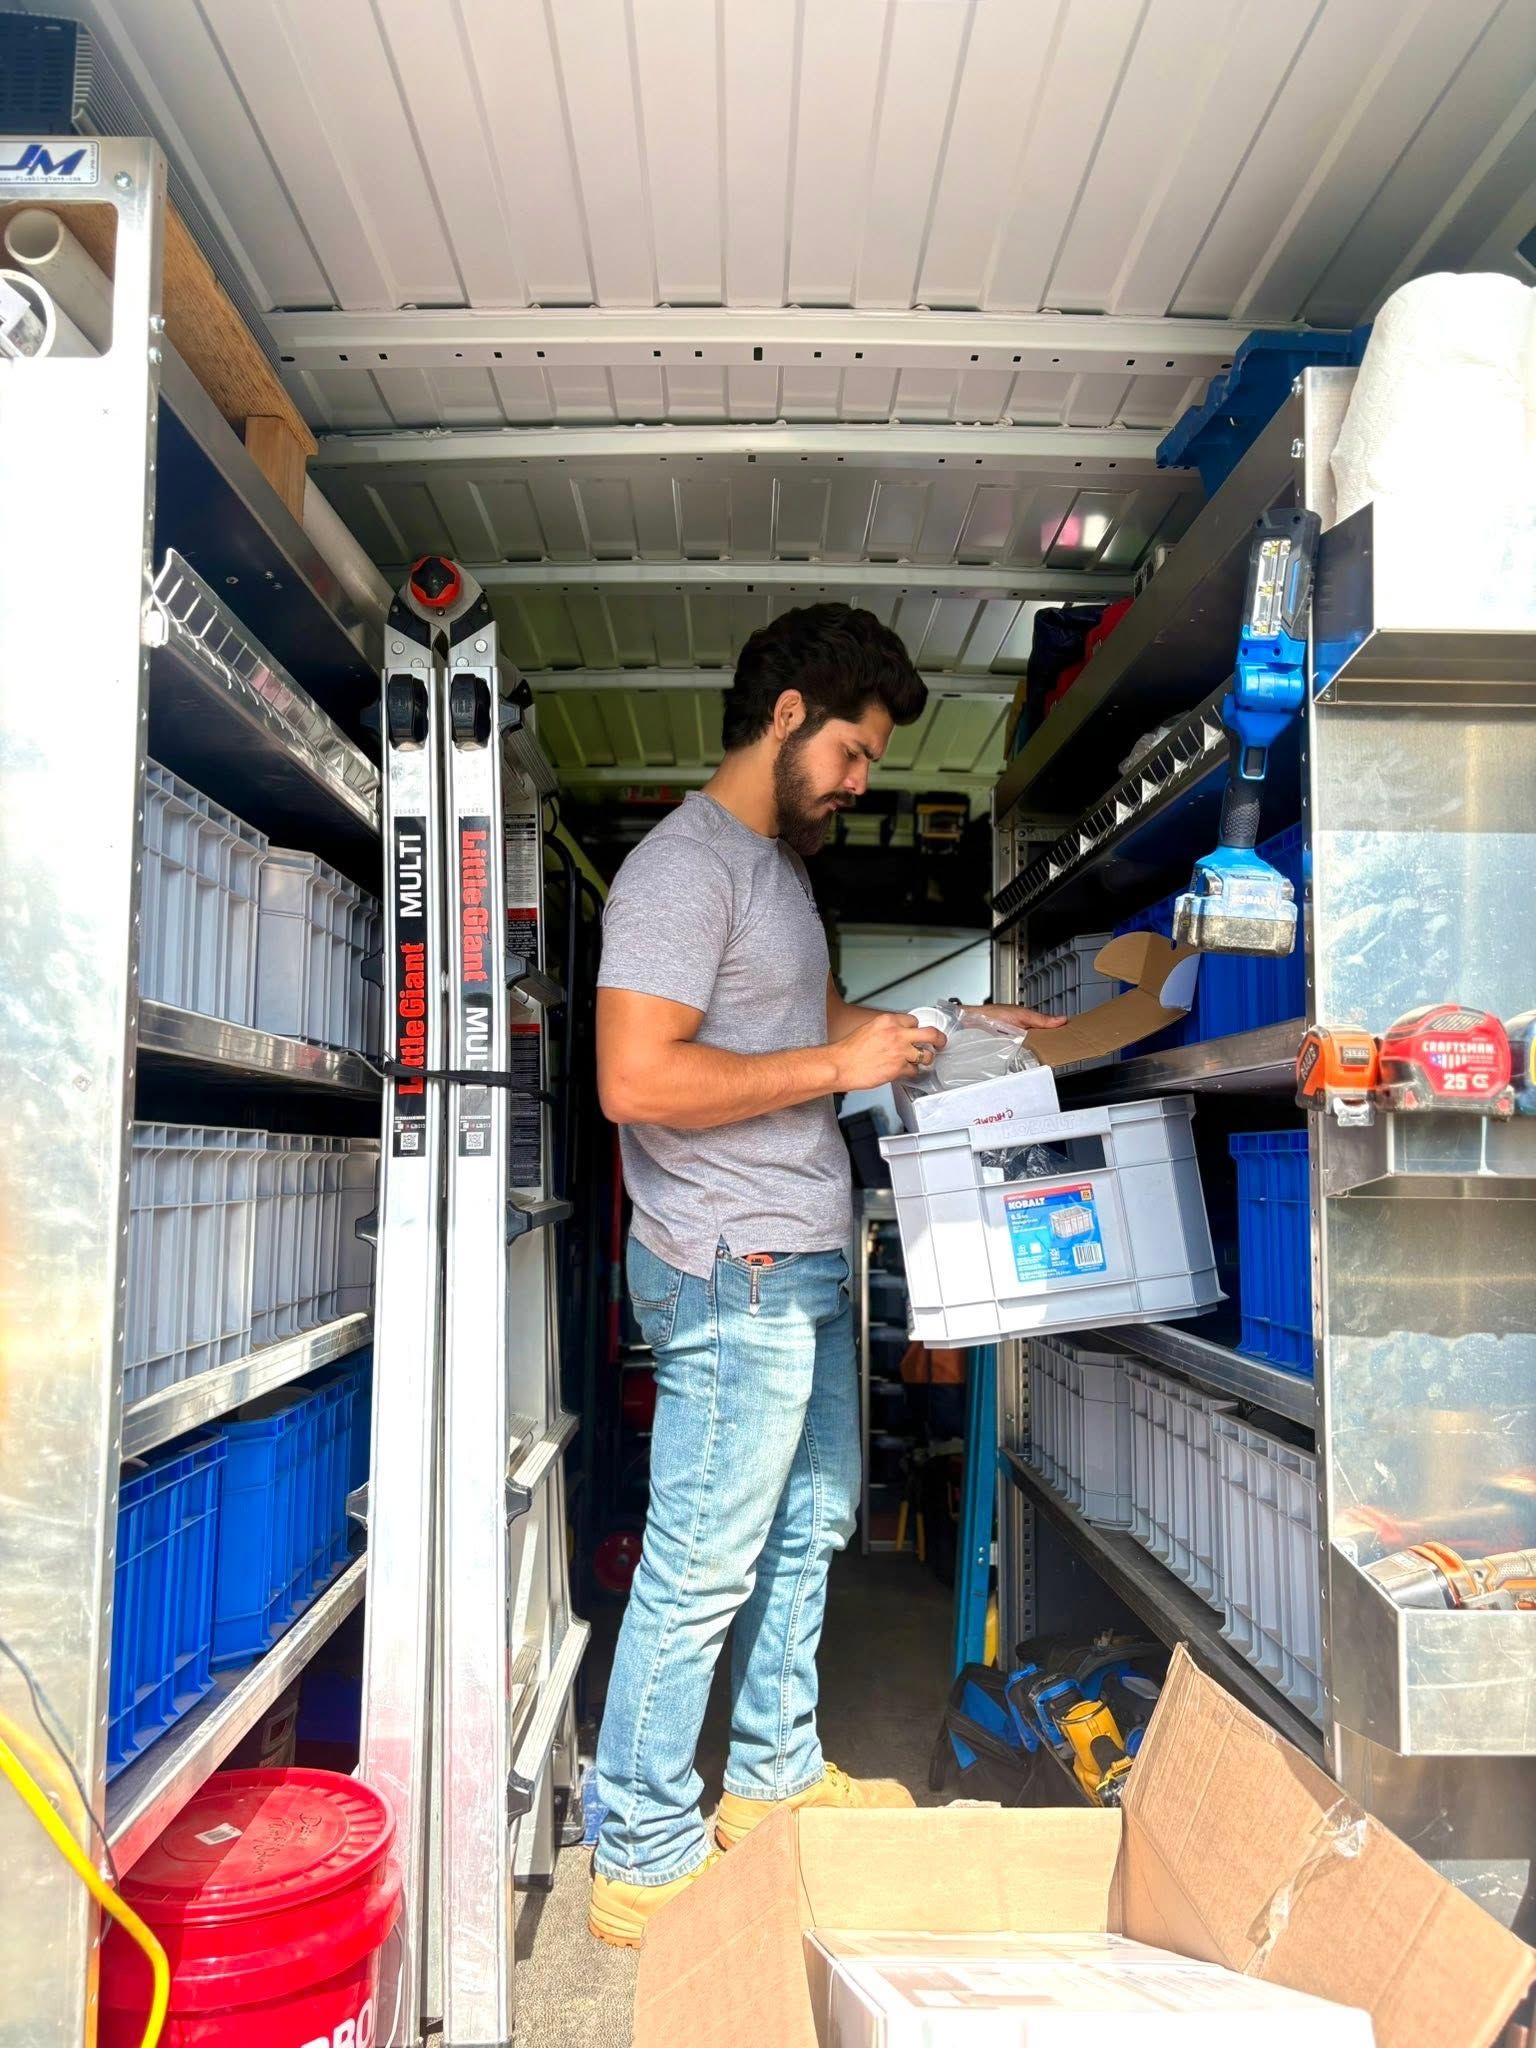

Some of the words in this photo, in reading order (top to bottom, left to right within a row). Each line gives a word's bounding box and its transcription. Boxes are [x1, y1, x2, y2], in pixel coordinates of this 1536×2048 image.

[0, 144, 88, 175] JM
[399, 835, 422, 917] MULTI
[462, 831, 488, 904] Little
[463, 907, 489, 983] Giant
[399, 941, 425, 1018] Giant
[1422, 1041, 1494, 1054] CRAFTSMAN
[1443, 1073, 1467, 1090] 25
[974, 1109, 1014, 1125] CHROME
[1008, 1197, 1046, 1210] KOBALT
